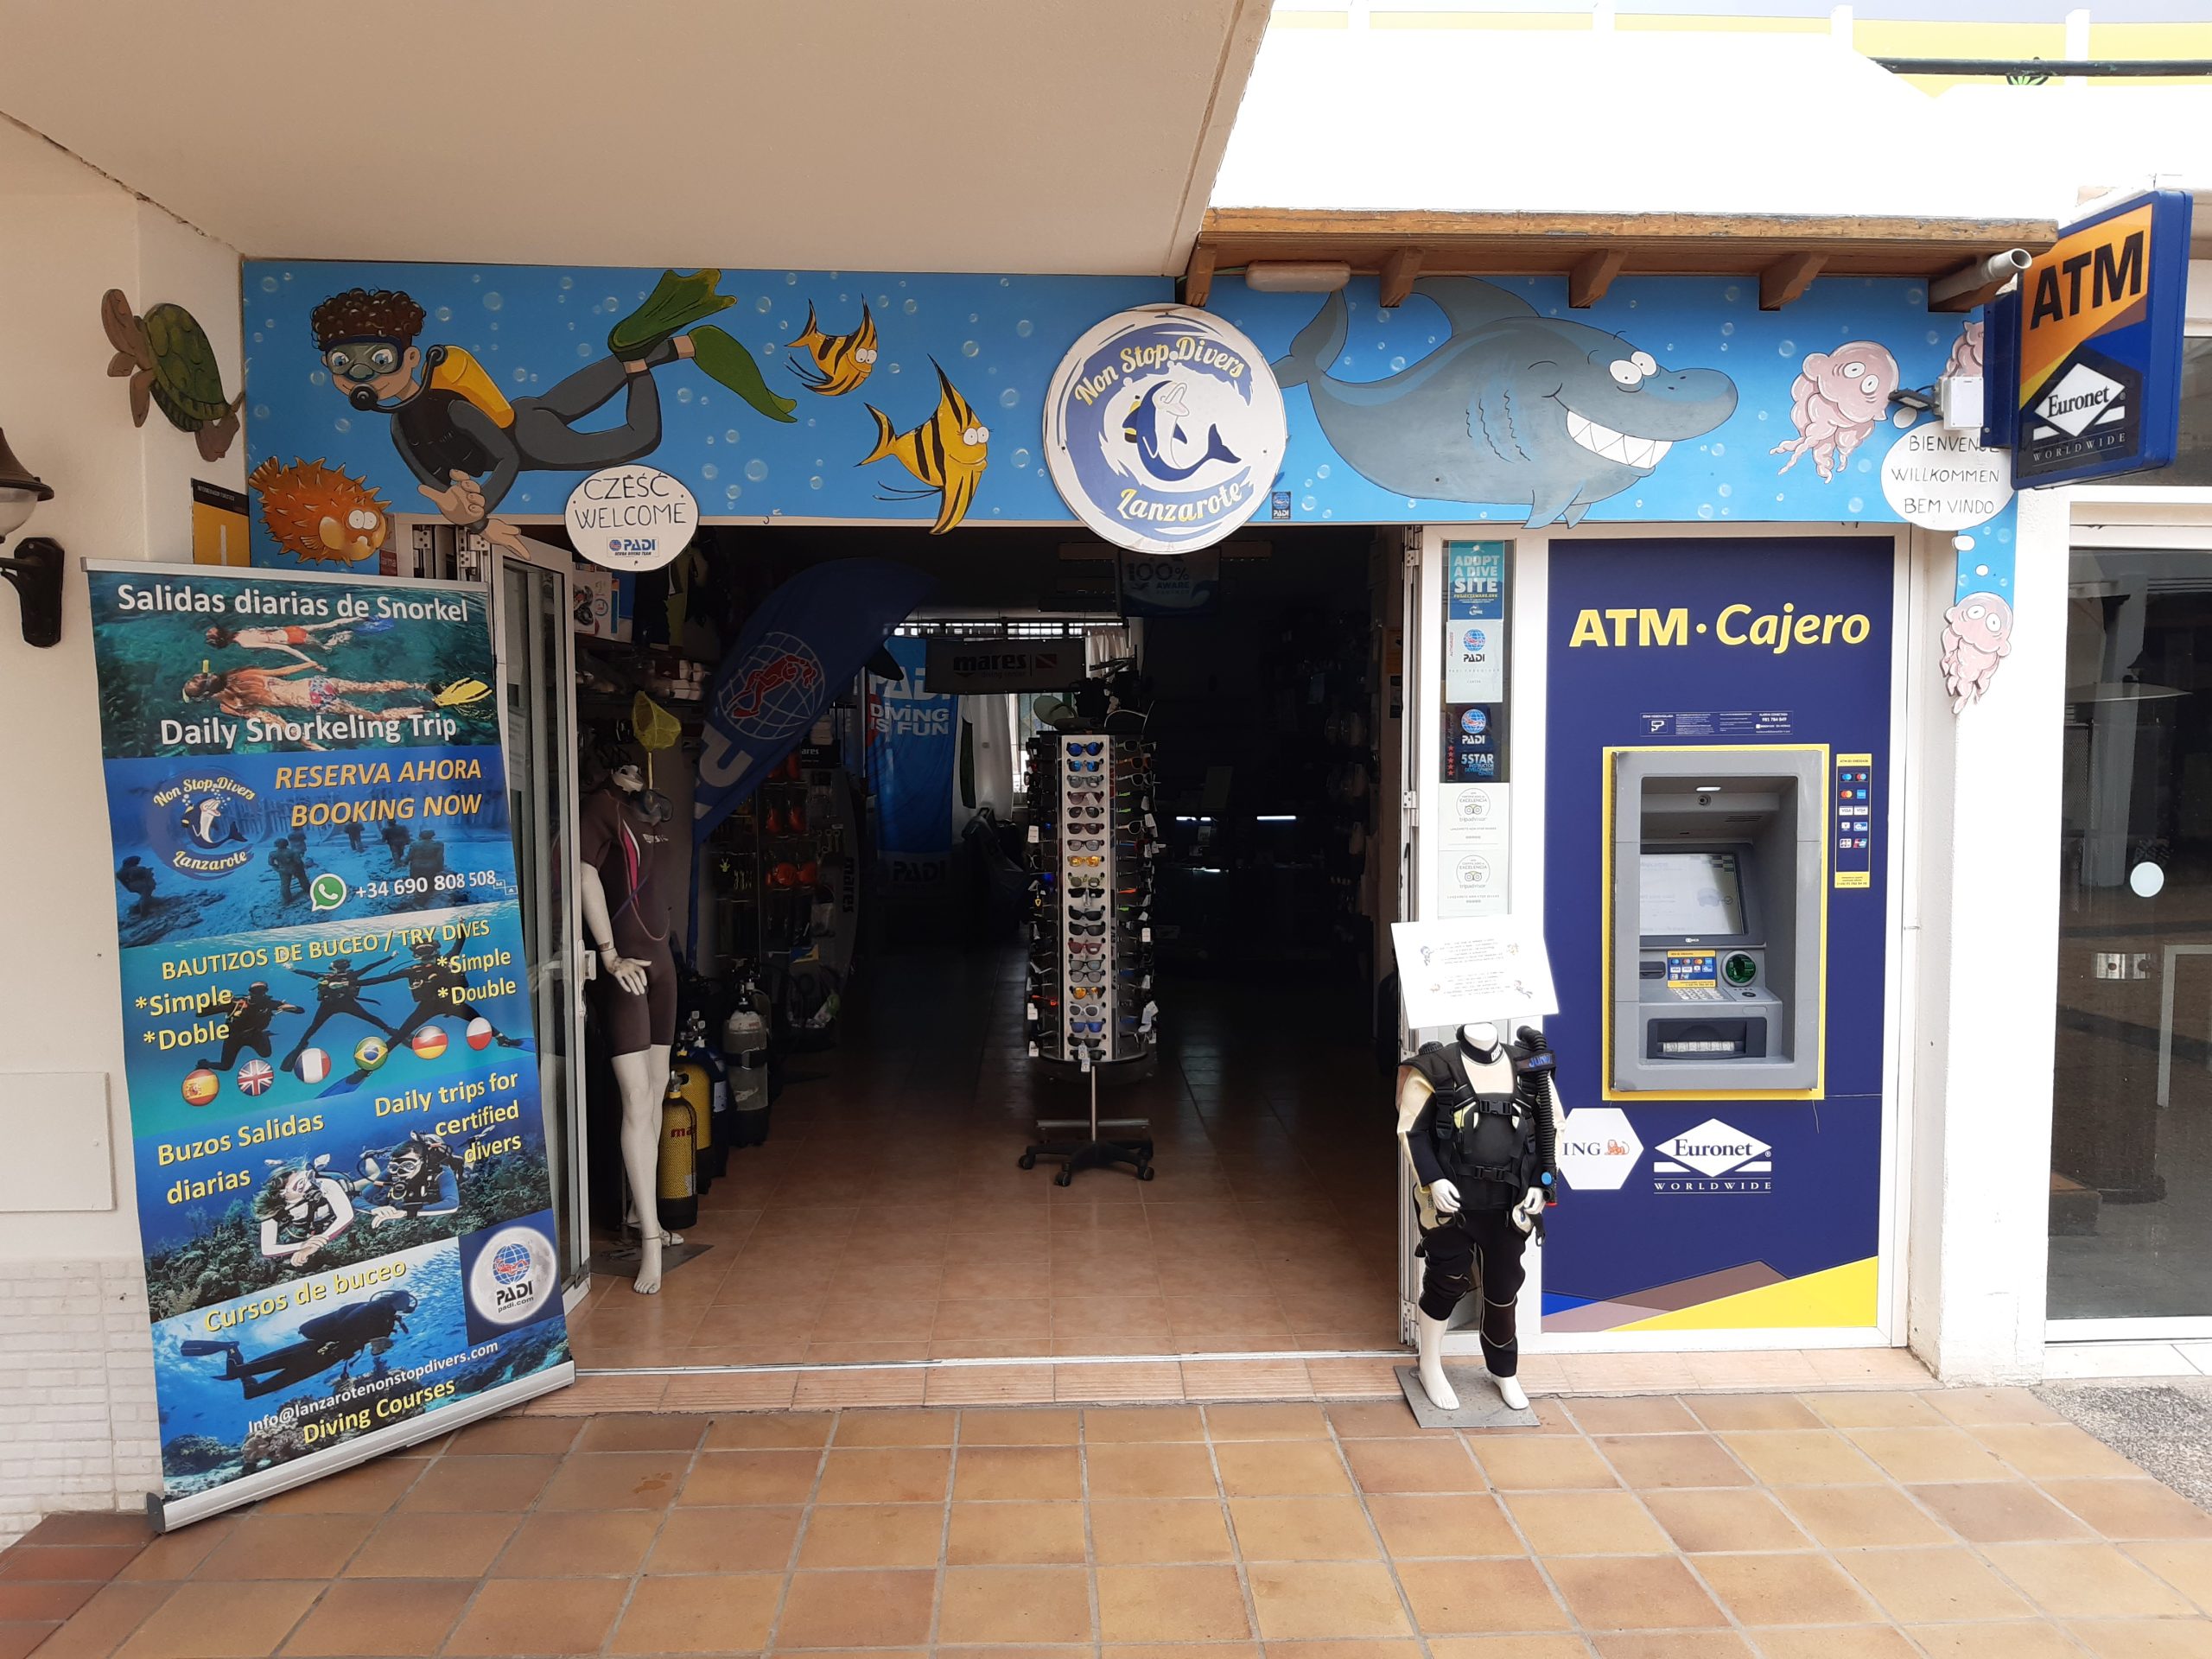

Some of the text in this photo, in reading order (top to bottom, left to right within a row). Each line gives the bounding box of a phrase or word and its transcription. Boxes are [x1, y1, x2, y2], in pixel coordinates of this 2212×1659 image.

[2030, 231, 2144, 330] ATM
[1075, 337, 1244, 406] Non Stop Divers
[2048, 385, 2110, 419] Euronet
[1909, 435, 1999, 453] BIENVEN
[2033, 433, 2126, 461] WORLDWIDE
[1891, 467, 1999, 482] WILLKOMMEN
[575, 502, 687, 529] WELCOME
[1117, 482, 1244, 522] Lanzarote
[1904, 498, 1994, 514] BEM VINDO
[624, 539, 657, 550] PADI
[1454, 555, 1500, 566] ADOPT
[1454, 566, 1497, 576] A DIVE
[1454, 577, 1497, 594] SITE
[118, 583, 468, 622] Salidas diarias de Snorkel
[1569, 602, 1871, 654] ATM Cajero
[953, 652, 1027, 672] mares
[1463, 654, 1485, 663] PADI
[160, 714, 457, 750] Daily Snorkeling Trip
[870, 718, 890, 733] IS
[897, 721, 949, 736] FUN
[1462, 735, 1486, 745] PADI
[275, 759, 482, 791] RESERVA AHORA
[153, 775, 256, 808] Non Stop Divers
[291, 793, 482, 829] BOOKING NOW
[172, 849, 249, 870] Lanzarote
[355, 869, 496, 899] +34 690 808 508
[162, 919, 491, 982] BAUTIZOS DE BUCEO / TRY DIVES
[375, 1070, 519, 1118] Daily trips for
[435, 1100, 519, 1139] certified
[157, 1111, 325, 1167] Buzos Salidas
[464, 1134, 522, 1165] divers
[1562, 1142, 1601, 1156] ING
[1673, 1138, 1753, 1157] Euronet
[166, 1166, 251, 1206] diarias
[1654, 1181, 1772, 1191] WORLDWIDE
[203, 1260, 408, 1333] Cursos de buceo
[496, 1280, 534, 1306] PADI
[497, 1295, 535, 1314] padi.com
[248, 1339, 499, 1435] Info@lanzarotenonstopdivers.com
[303, 1379, 456, 1446] Diving Courses
